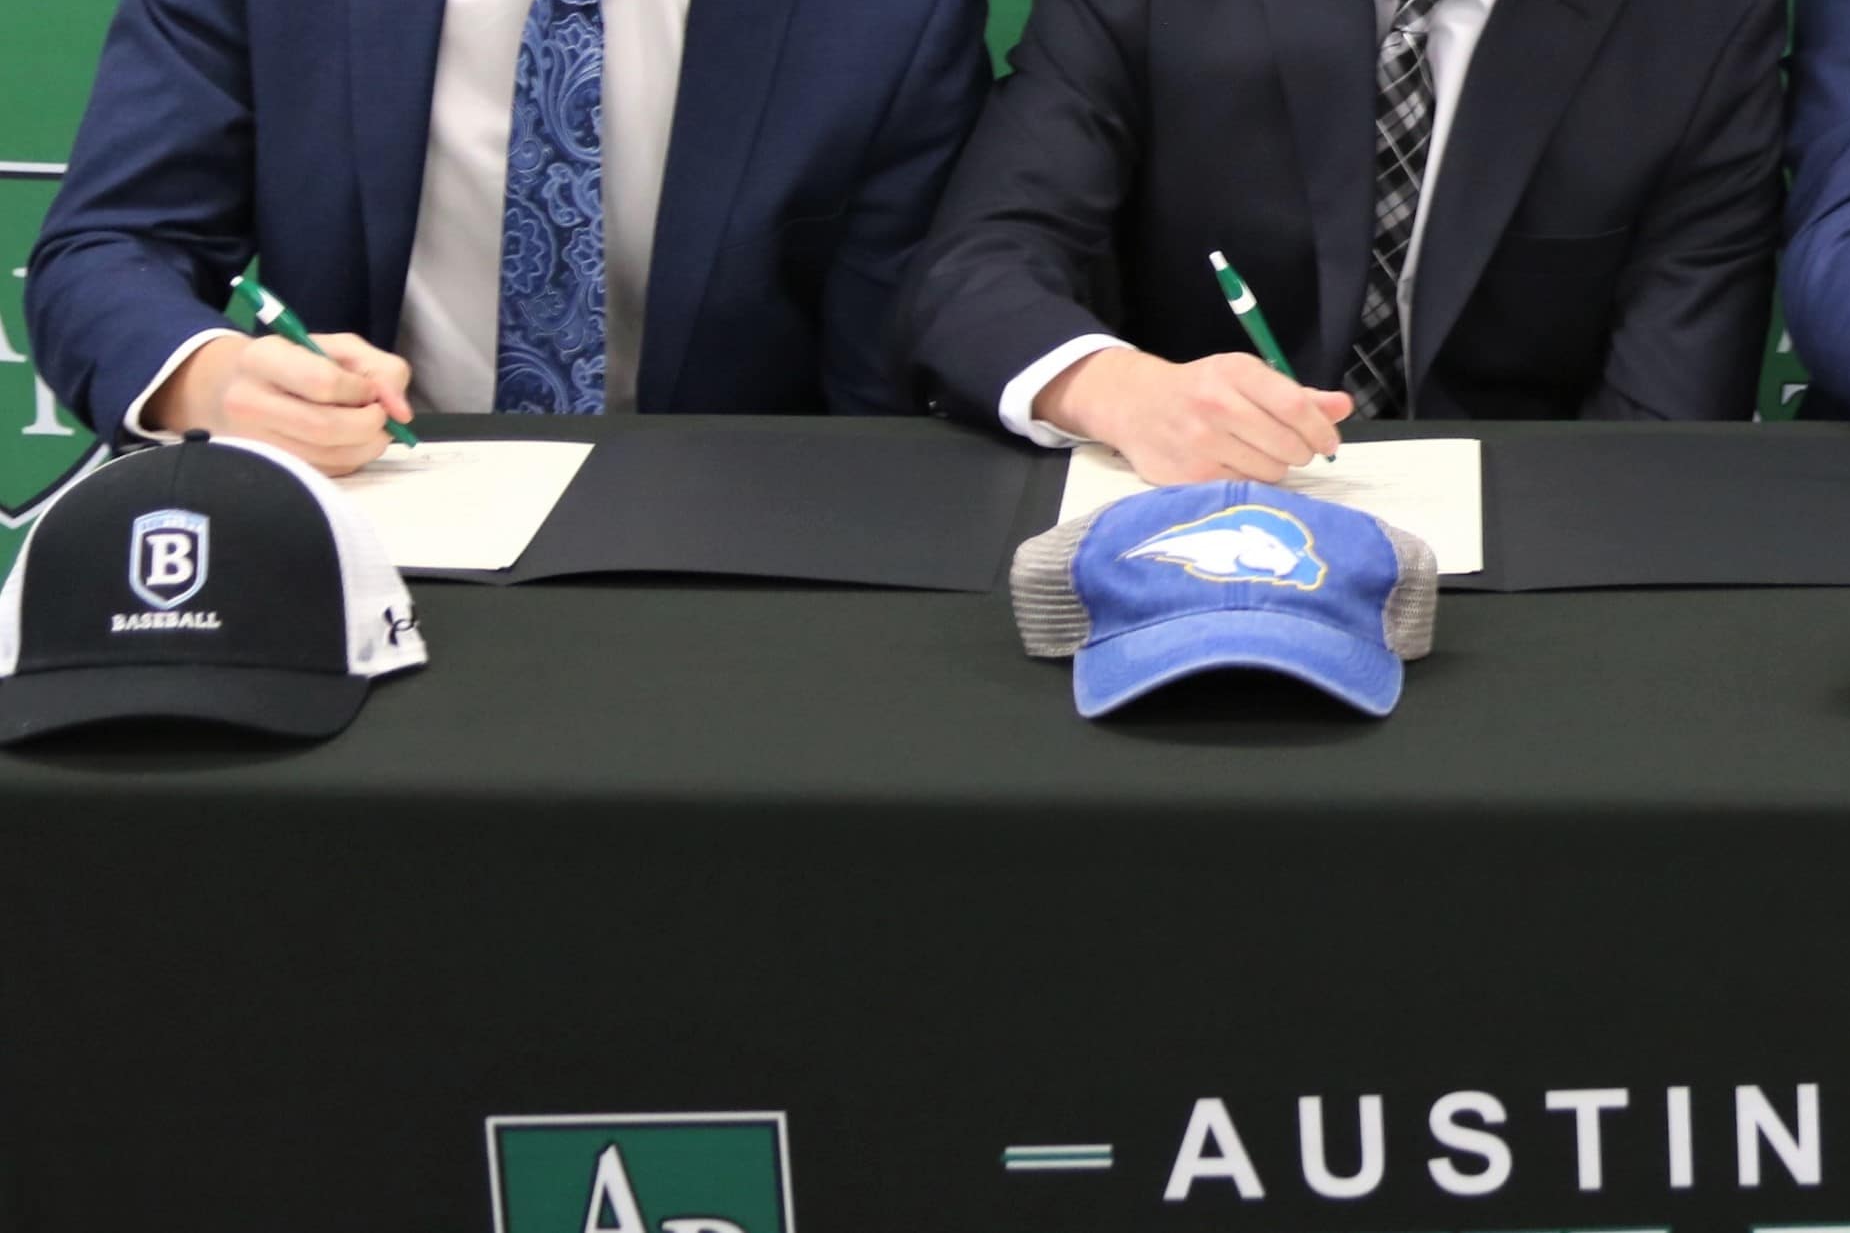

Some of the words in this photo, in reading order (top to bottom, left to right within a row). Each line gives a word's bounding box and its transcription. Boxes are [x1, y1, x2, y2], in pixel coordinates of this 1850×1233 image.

[145, 532, 194, 587] B
[110, 610, 224, 632] BASEBALL
[1163, 1083, 1822, 1200] AUSTIN
